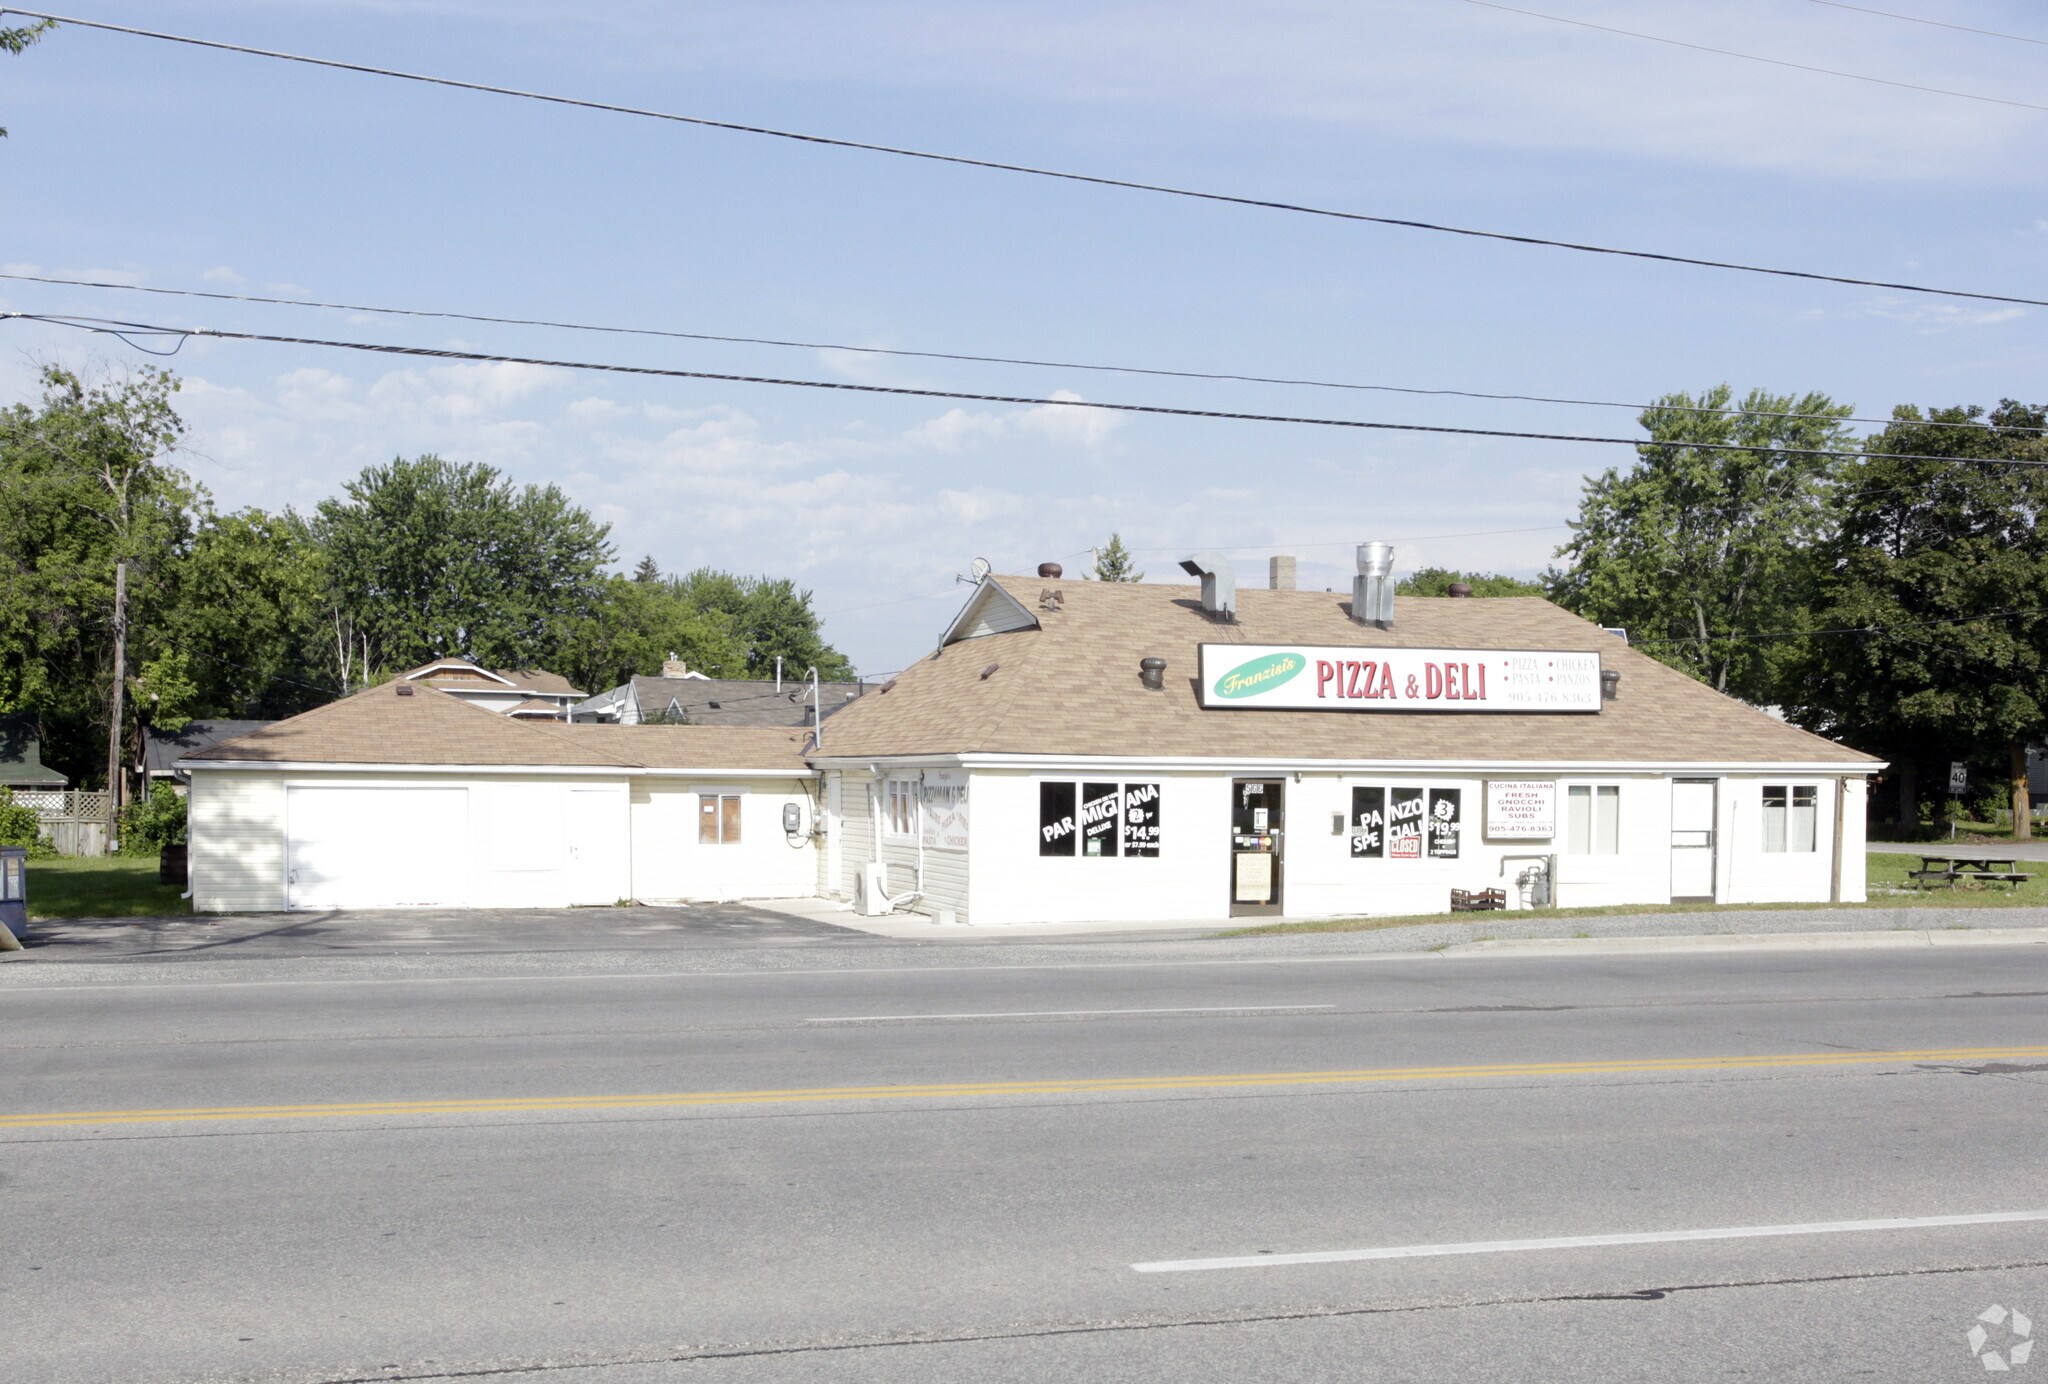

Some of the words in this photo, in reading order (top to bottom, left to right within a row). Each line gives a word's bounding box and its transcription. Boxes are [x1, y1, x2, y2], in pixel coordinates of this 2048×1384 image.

[1512, 657, 1538, 671] PIZZA
[1556, 658, 1596, 671] CHICKEN
[1316, 660, 1397, 699] PIZZA
[1405, 674, 1420, 699] &
[1424, 662, 1487, 700] DELI
[1512, 673, 1541, 685] PASTA
[1556, 673, 1592, 686] PANZOS
[1508, 692, 1531, 703] 905
[1536, 692, 1558, 703] 476
[1562, 692, 1592, 704] 8363
[1952, 772, 1965, 783] 40
[1042, 816, 1076, 843] PAR
[1081, 799, 1118, 826] MIGI
[1126, 784, 1159, 809] ANA
[1132, 810, 1141, 821] 2
[1360, 809, 1384, 830] PA
[1390, 798, 1423, 822] NZO
[1439, 802, 1448, 817] 3
[1086, 820, 1112, 836] DELUXE
[1124, 825, 1160, 841] $14.99
[1428, 821, 1461, 836] $19.99
[947, 836, 968, 846] CHICKEN
[1353, 831, 1380, 853] SPE
[1389, 819, 1423, 842] CIAL!
[1392, 839, 1418, 853] CLOSED
